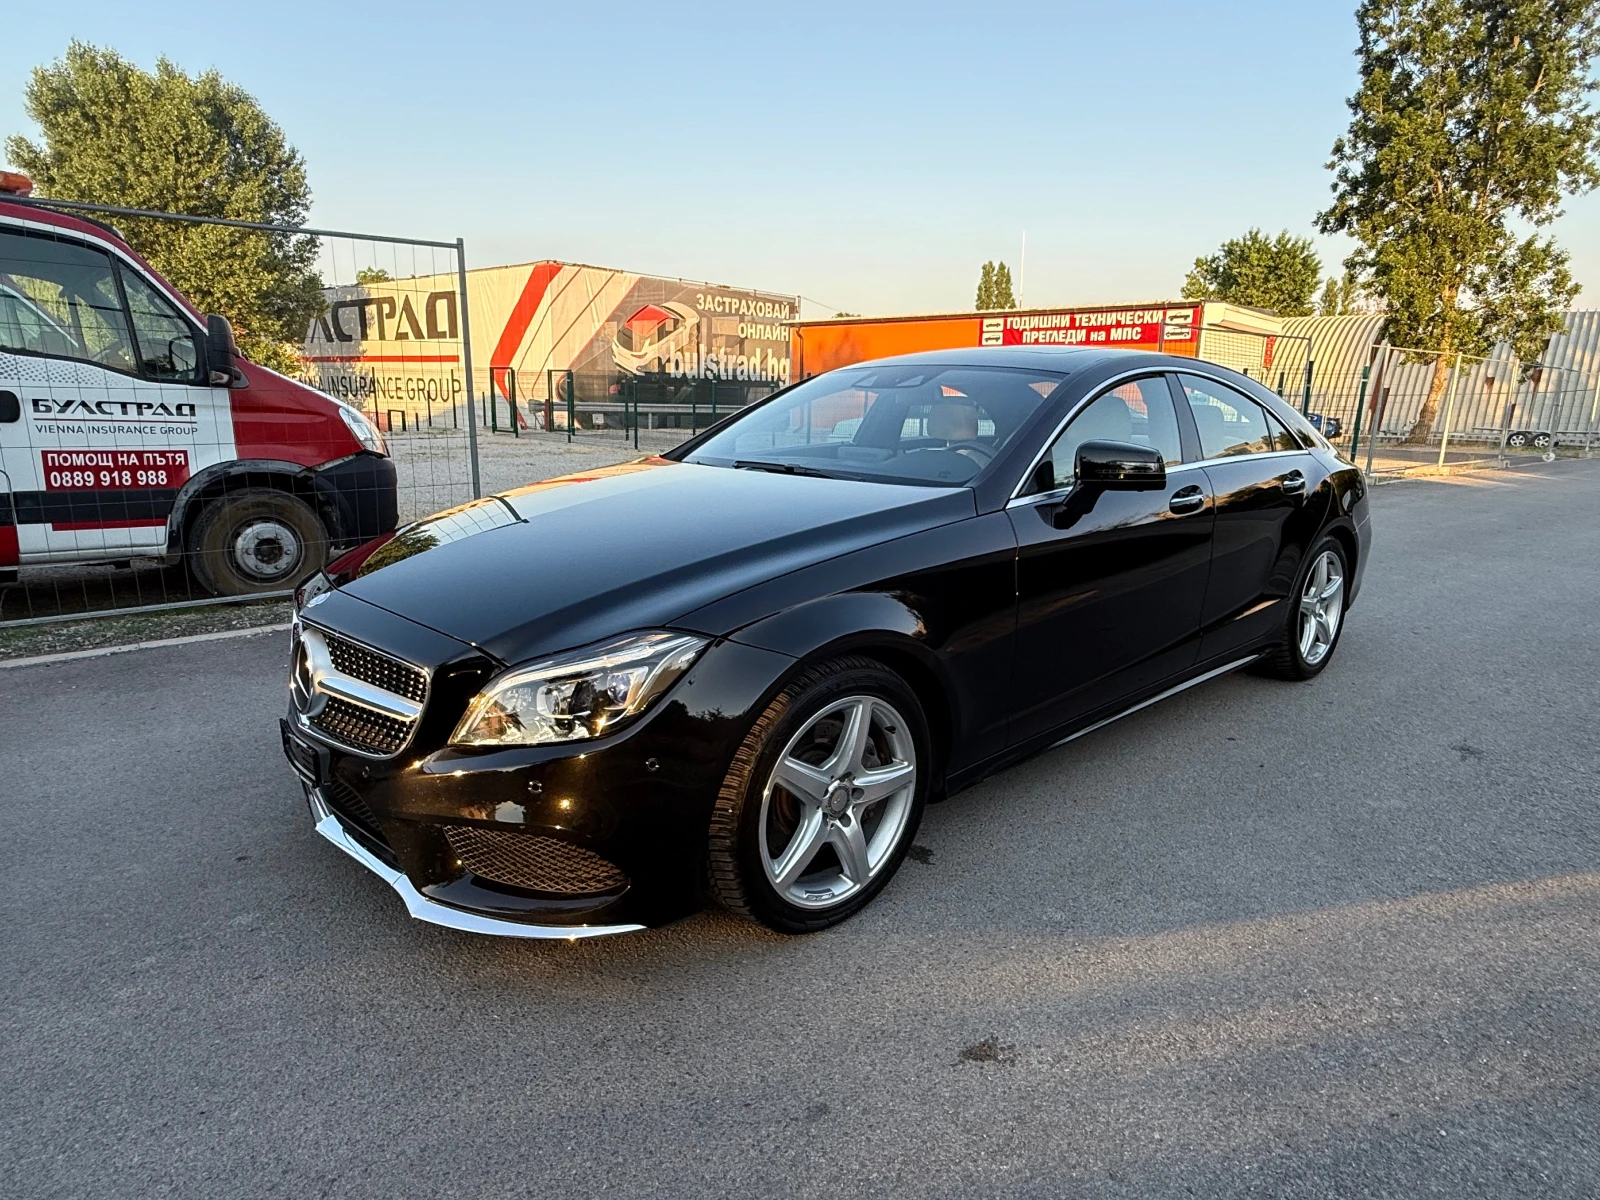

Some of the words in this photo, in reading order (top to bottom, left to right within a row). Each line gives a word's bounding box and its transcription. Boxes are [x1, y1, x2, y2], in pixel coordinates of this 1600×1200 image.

[696, 293, 790, 320] ЗАСТРАХОВАЙ
[1006, 314, 1071, 332] ГОДИШНИ
[1074, 309, 1164, 328] ТЕХНИЧЕСКИ
[737, 321, 789, 342] ОНЛАЙН
[1022, 328, 1087, 345] ПРЕГЛЕДИ
[1089, 330, 1106, 342] на
[1110, 326, 1142, 341] МПС
[669, 340, 791, 390] bulstrad.bg
[327, 375, 404, 400] INSURANCE
[406, 376, 462, 403] GROUP
[35, 424, 85, 435] VIENNA
[88, 425, 157, 436] INSURANCE
[160, 426, 198, 436] GROUP
[47, 453, 114, 468] ПОМОЩ
[118, 453, 140, 466] НА
[143, 453, 186, 467] ПЪТЯ
[50, 471, 95, 487] 0889
[100, 471, 132, 486] 918
[136, 470, 168, 486] 988
